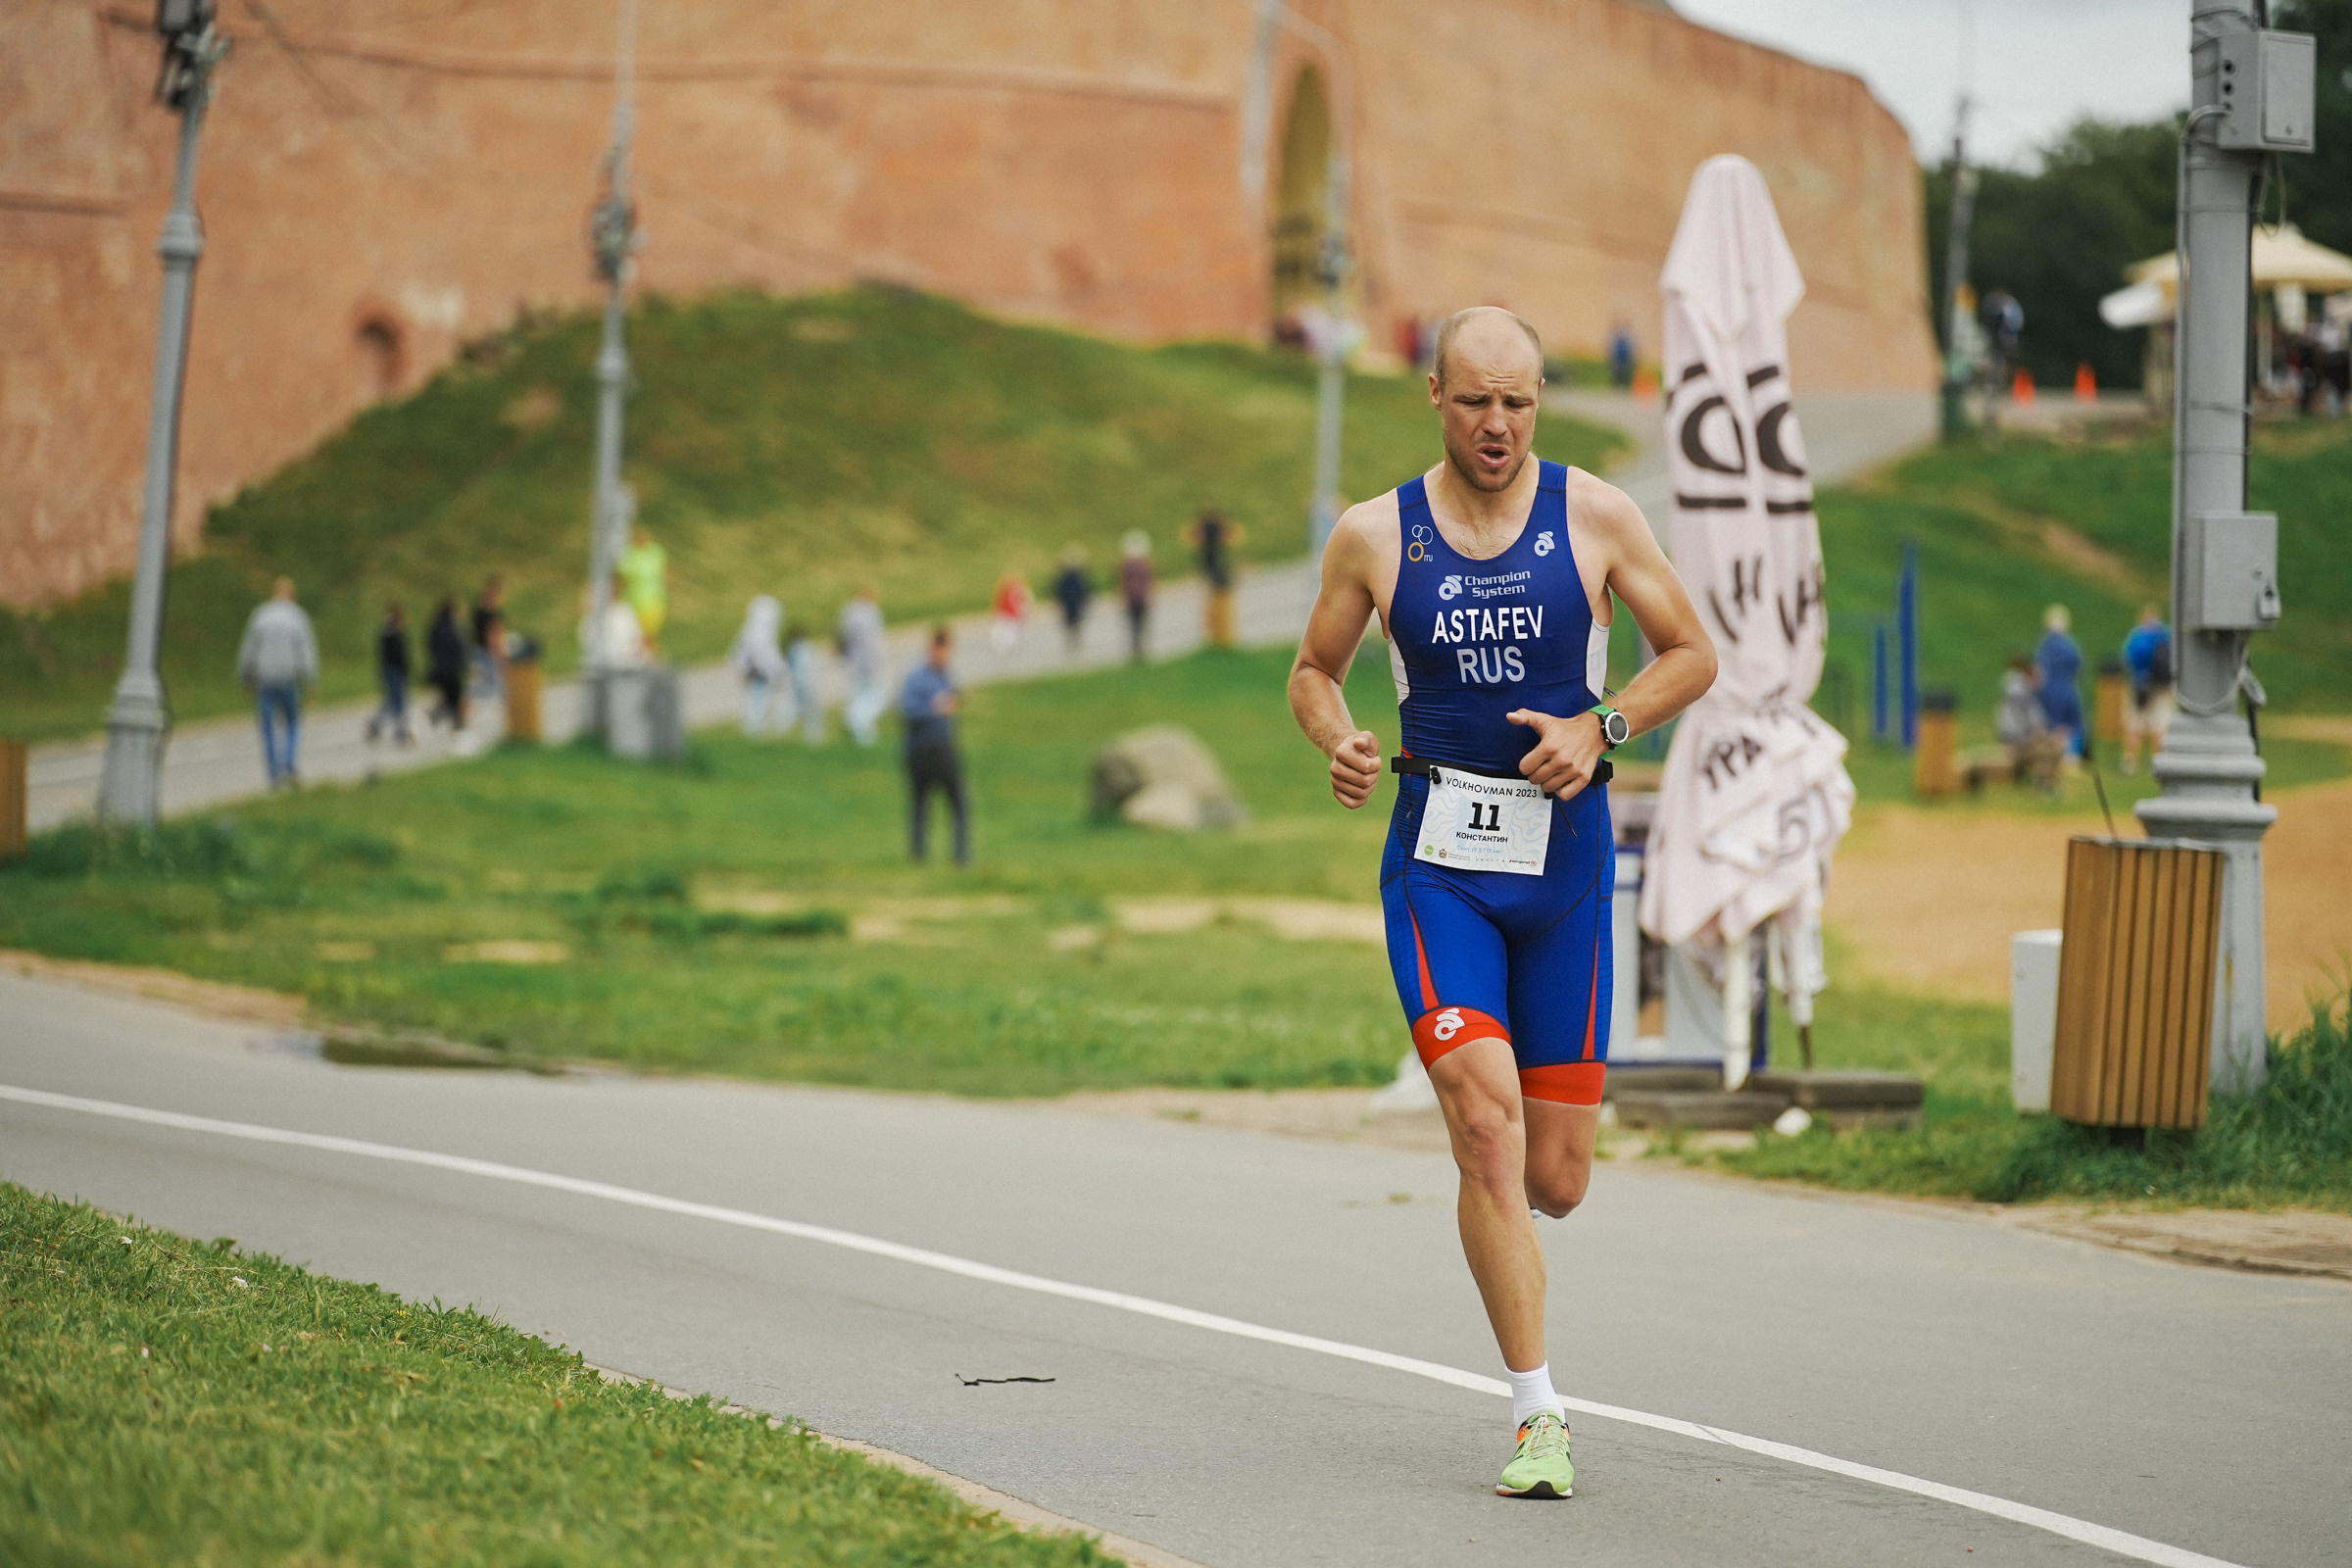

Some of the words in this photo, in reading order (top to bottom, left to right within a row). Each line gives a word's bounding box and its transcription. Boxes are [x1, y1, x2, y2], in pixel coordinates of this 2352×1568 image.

[1465, 570, 1531, 586] Champion
[1472, 584, 1525, 599] System
[1432, 606, 1544, 643] ASTAFEV
[1456, 646, 1526, 683] RUS
[1446, 776, 1513, 797] VOLKHOVMAN
[1515, 789, 1538, 798] 2023
[1468, 802, 1500, 831] 11
[1455, 831, 1508, 843] КОНСТАНТИН
